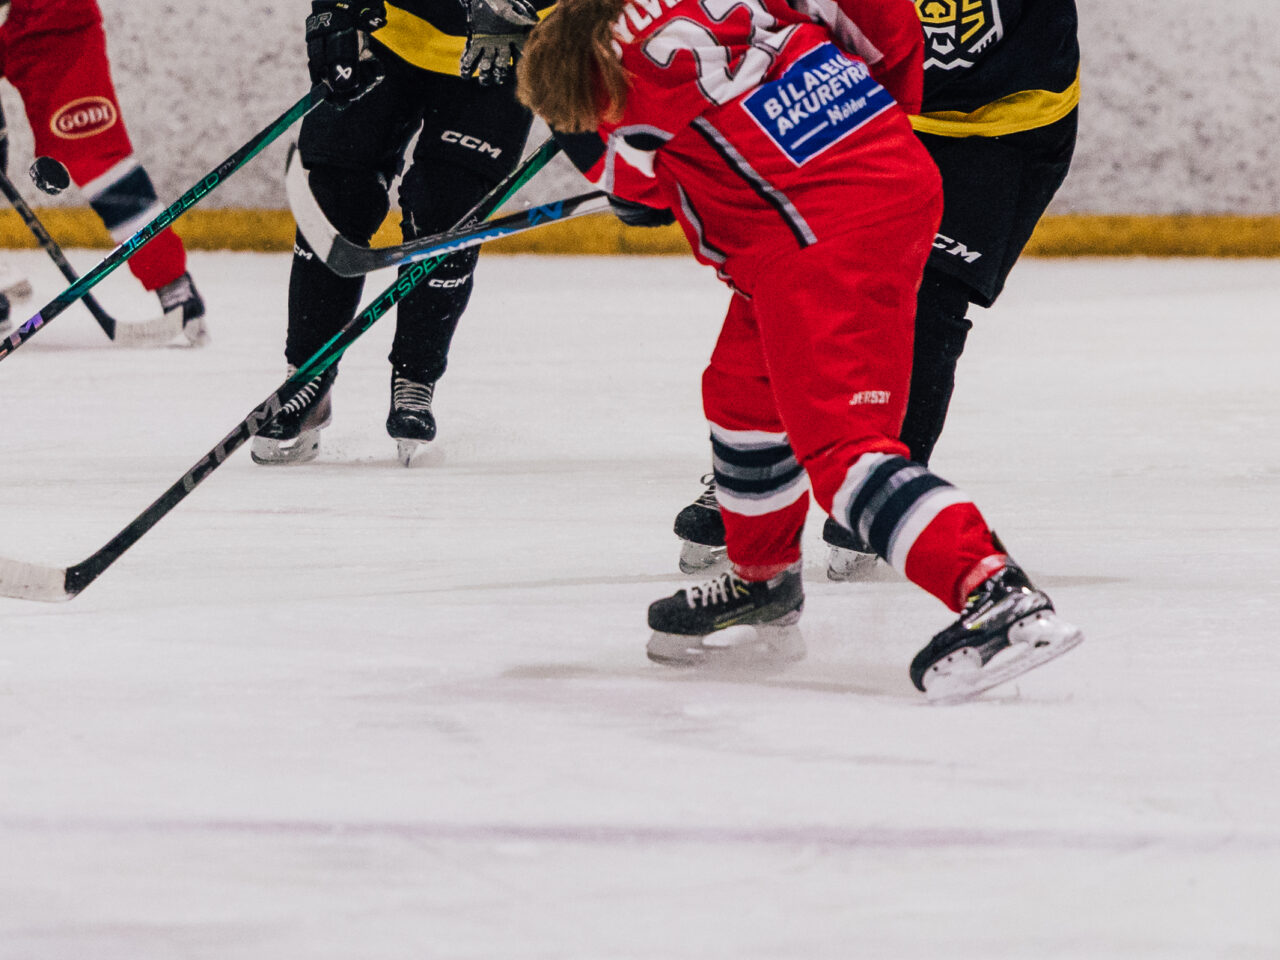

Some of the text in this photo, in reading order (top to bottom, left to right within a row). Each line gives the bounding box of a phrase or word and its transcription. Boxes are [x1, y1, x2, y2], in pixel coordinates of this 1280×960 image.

[440, 129, 503, 159] CCM
[122, 172, 220, 259] JETSPEED
[293, 243, 314, 260] CM
[932, 232, 983, 264] CM
[361, 253, 450, 332] JETSPE
[183, 392, 281, 494] CCM
